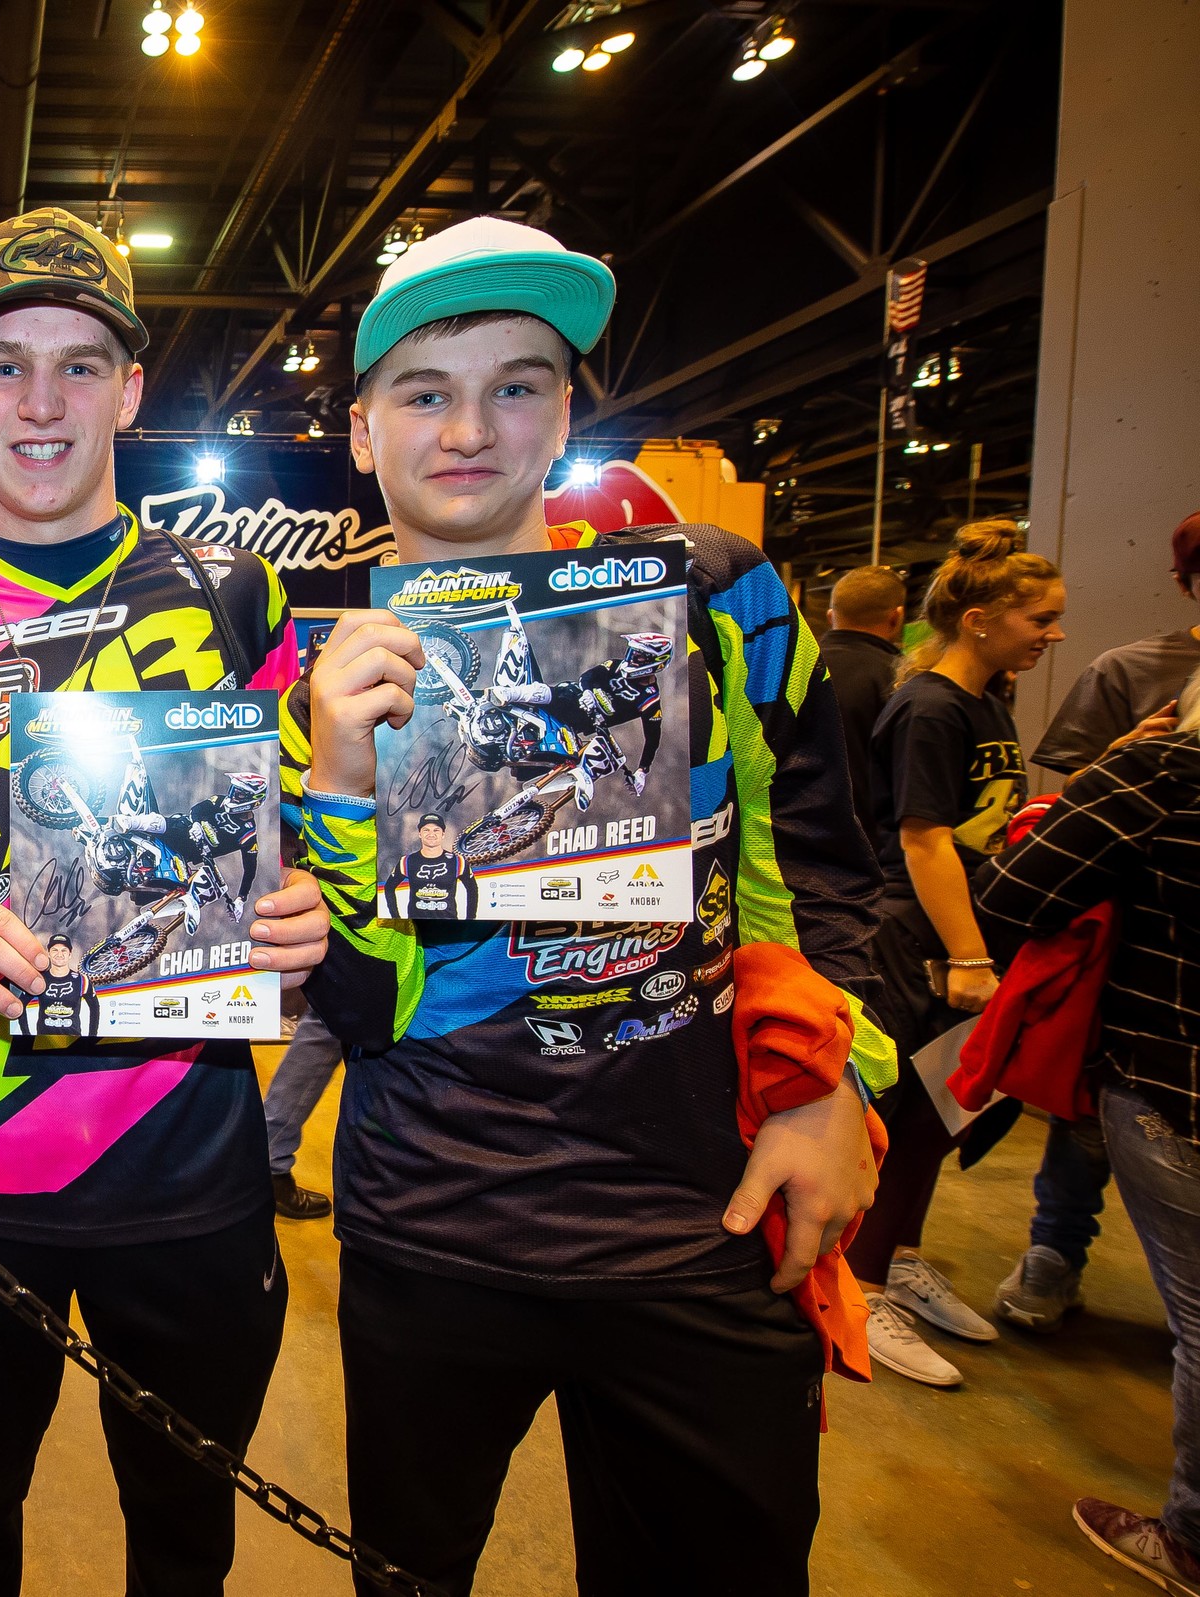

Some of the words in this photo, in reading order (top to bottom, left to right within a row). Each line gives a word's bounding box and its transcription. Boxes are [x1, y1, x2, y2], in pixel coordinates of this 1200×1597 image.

[403, 572, 512, 594] MOUNTAIN
[548, 557, 667, 592] cbdMD
[391, 584, 521, 607] MOTORSPORTS
[165, 702, 263, 740] cbdMD
[546, 825, 598, 856] CHAD
[605, 815, 657, 848] REED
[542, 890, 559, 900] CR
[561, 890, 576, 899] 22
[630, 897, 661, 906] KNOBBY
[160, 948, 204, 977] CHAD
[209, 941, 251, 972] REED
[535, 920, 680, 977] Engines
[608, 954, 654, 976] .com
[530, 987, 633, 1003] WORKS
[645, 972, 681, 996] Arai
[155, 1008, 169, 1017] CR
[171, 1009, 184, 1017] 22
[536, 996, 633, 1010] CONNECTION
[228, 1015, 255, 1024] KNOBBY
[615, 1019, 657, 1041] Dirt
